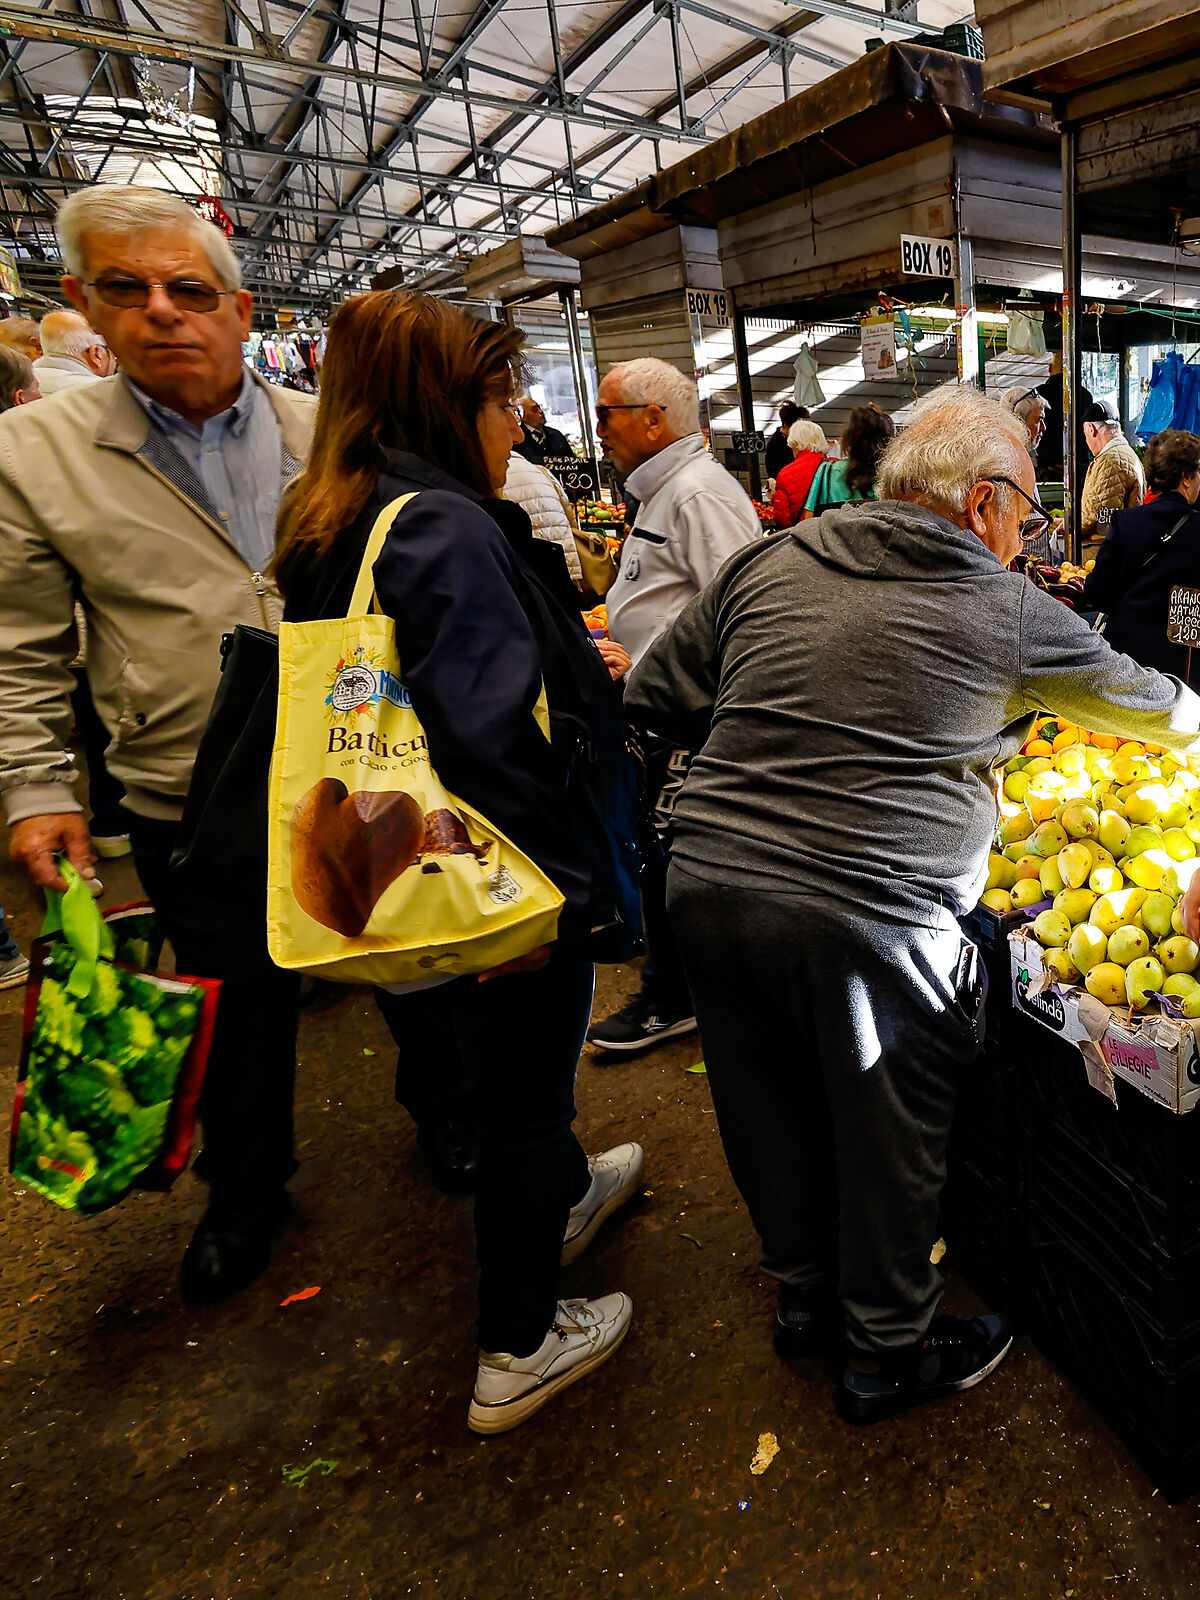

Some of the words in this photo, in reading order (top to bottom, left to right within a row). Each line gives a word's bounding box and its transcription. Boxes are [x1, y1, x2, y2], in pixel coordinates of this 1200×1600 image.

[902, 240, 933, 275] BOX
[936, 244, 952, 277] 19
[687, 291, 712, 315] BOX
[713, 294, 727, 316] 19
[1108, 1038, 1118, 1050] LE
